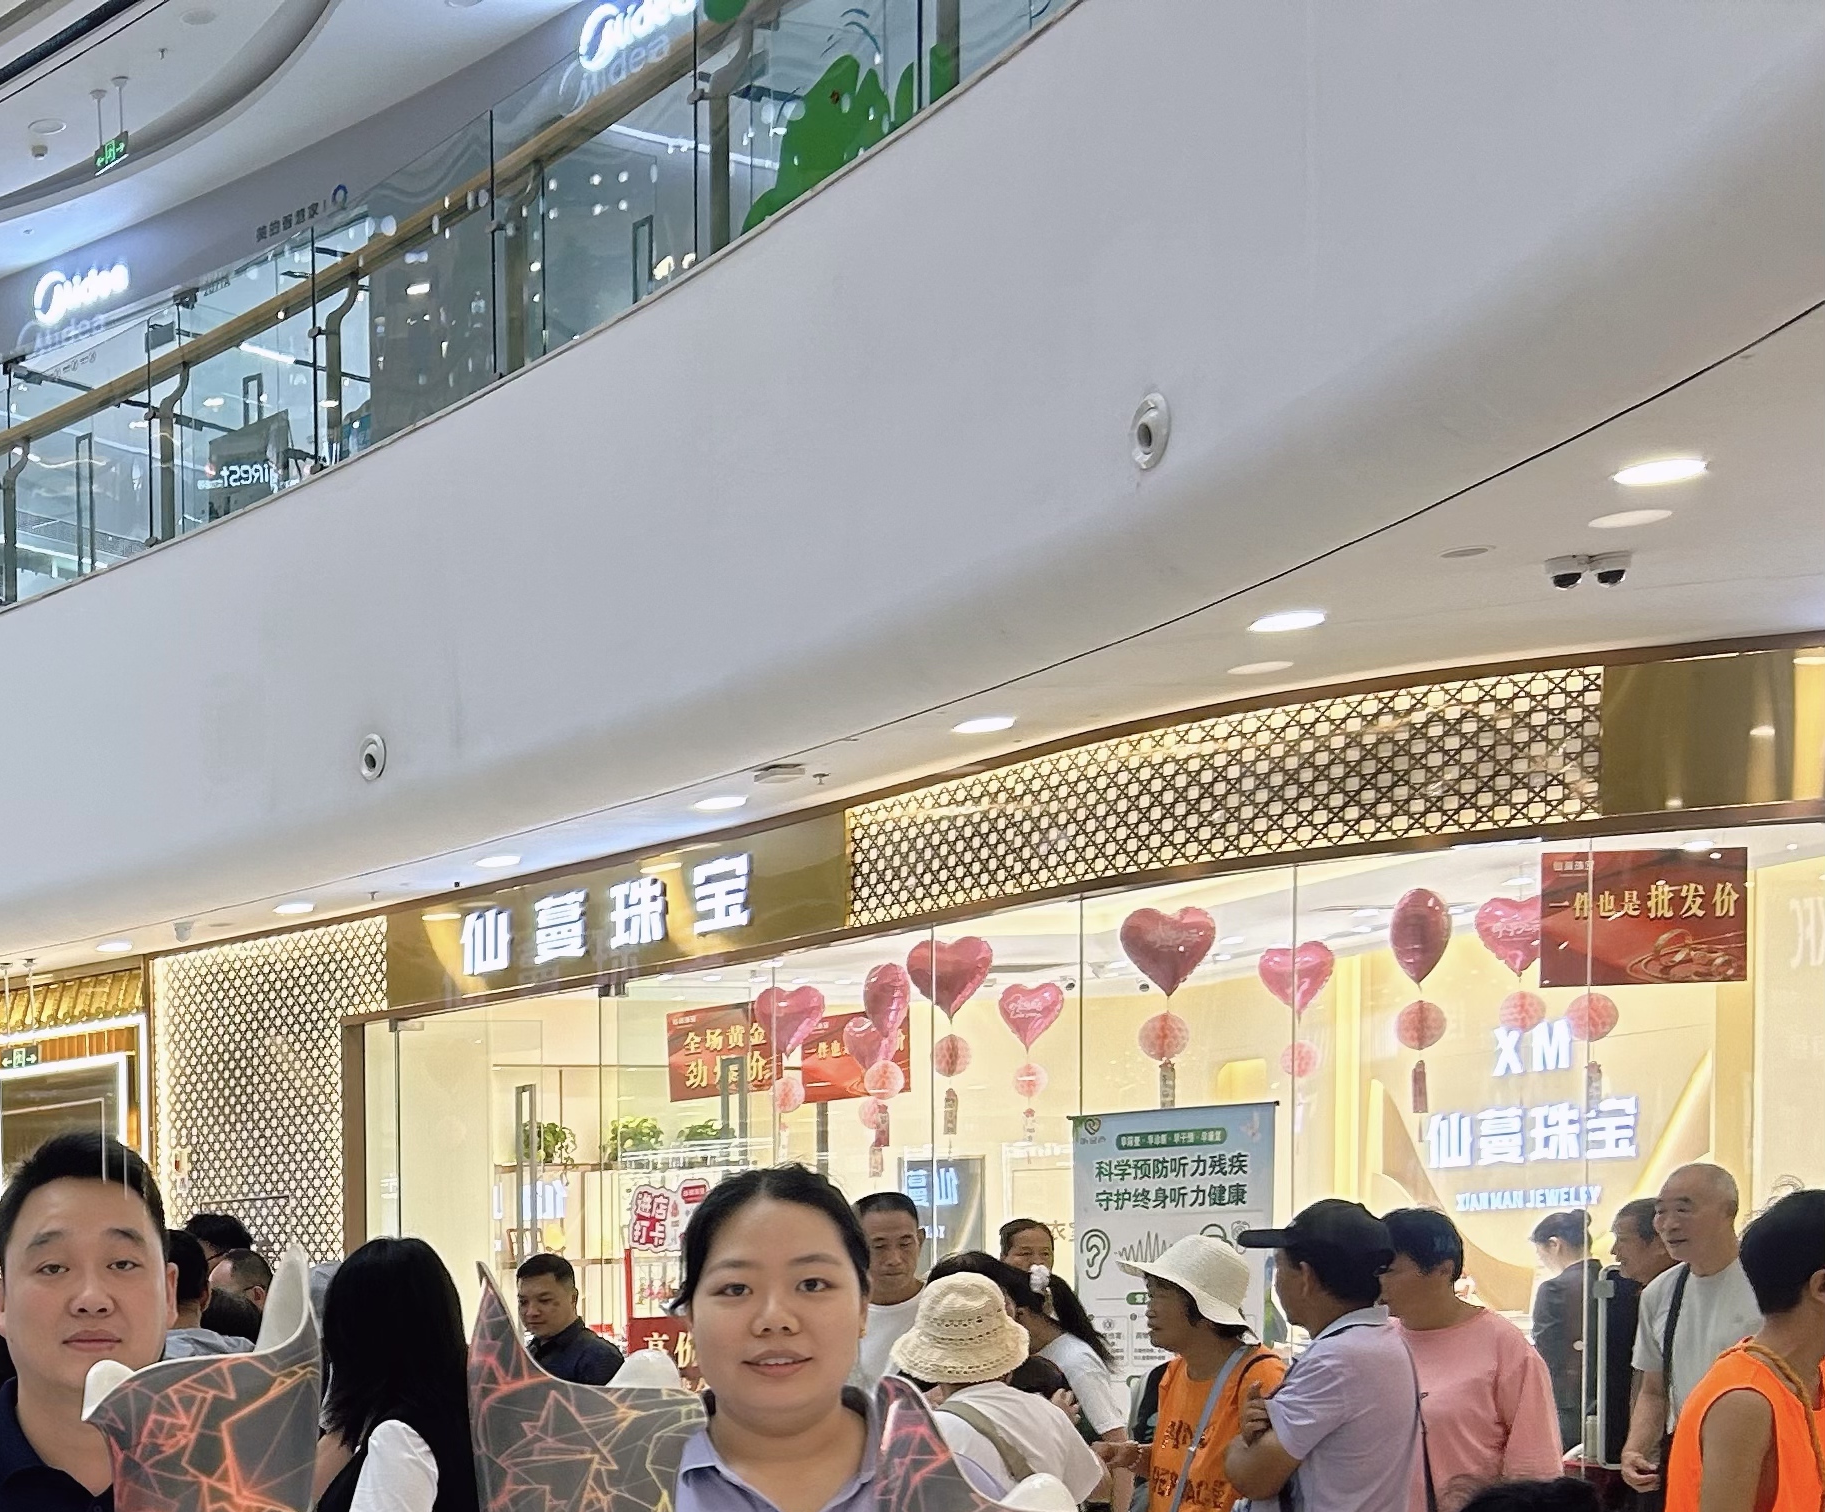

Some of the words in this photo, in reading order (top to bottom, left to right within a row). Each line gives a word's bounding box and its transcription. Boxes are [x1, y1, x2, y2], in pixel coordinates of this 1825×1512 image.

[460, 852, 753, 976] 仙蔓珠宝
[1549, 881, 1740, 919] 一件也是批发价
[683, 1022, 767, 1055] 全场黄金
[1426, 1095, 1639, 1169] 仙蔓珠宝
[1094, 1152, 1249, 1182] 科学预防听力残疾
[1094, 1182, 1248, 1211] 守护终身听力健康
[632, 1220, 667, 1248] 打卡
